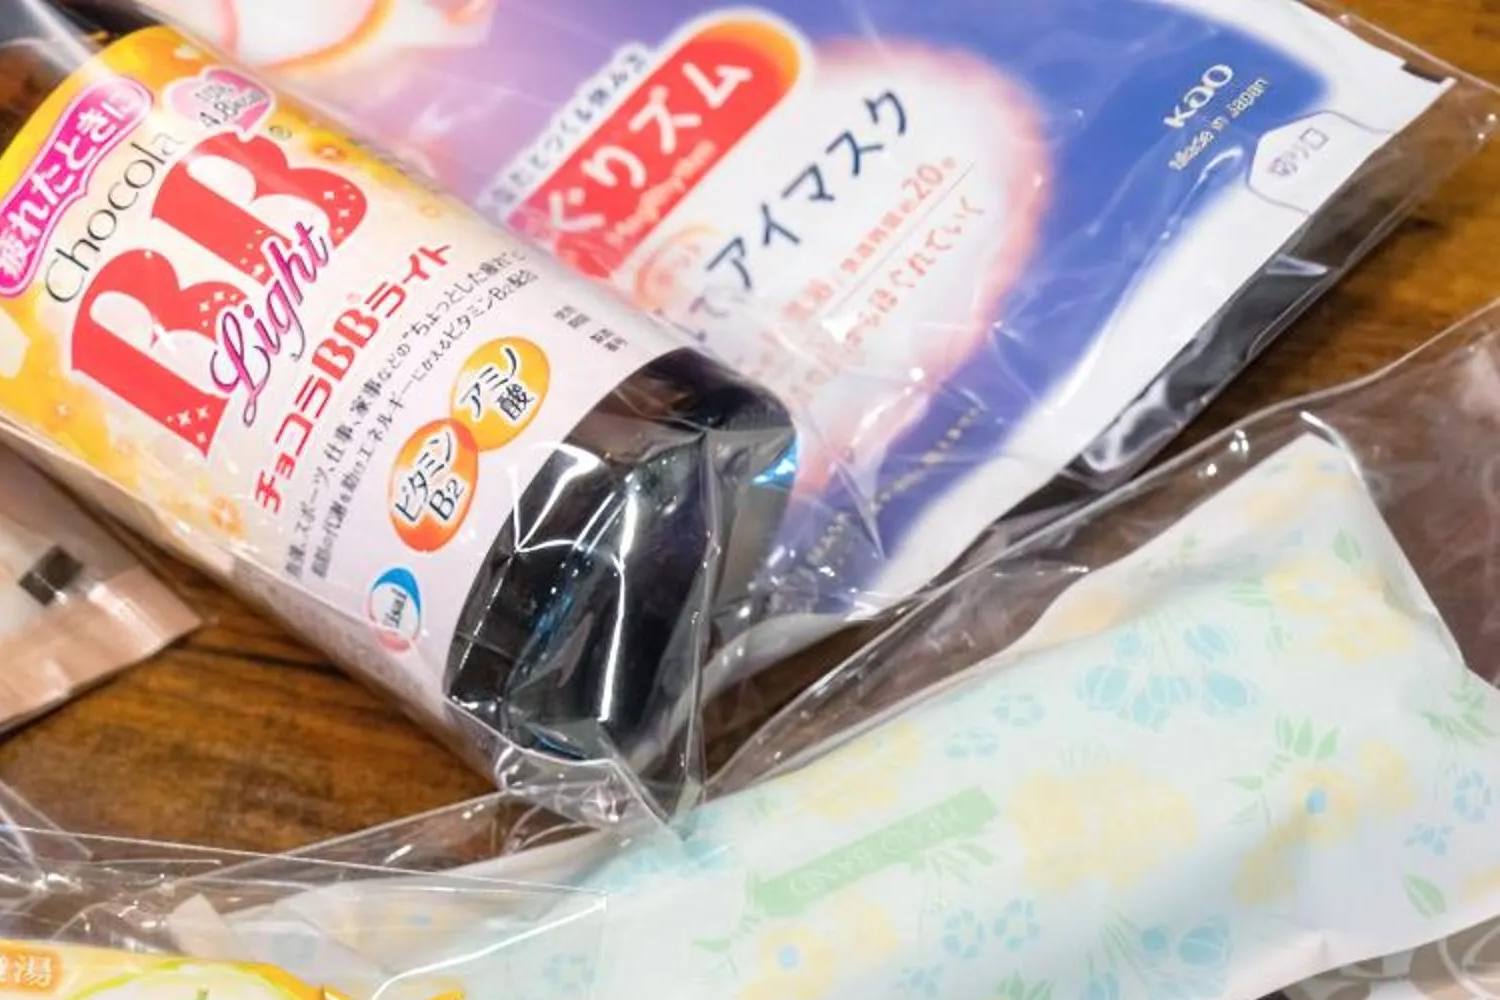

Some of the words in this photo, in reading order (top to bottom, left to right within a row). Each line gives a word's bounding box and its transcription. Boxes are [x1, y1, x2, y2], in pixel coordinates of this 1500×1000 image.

[210, 220, 331, 428] Light
[254, 241, 453, 514] チョコラBBライト
[456, 347, 520, 419] アミノ
[496, 379, 535, 422] 酸
[395, 428, 460, 525] ビタミン
